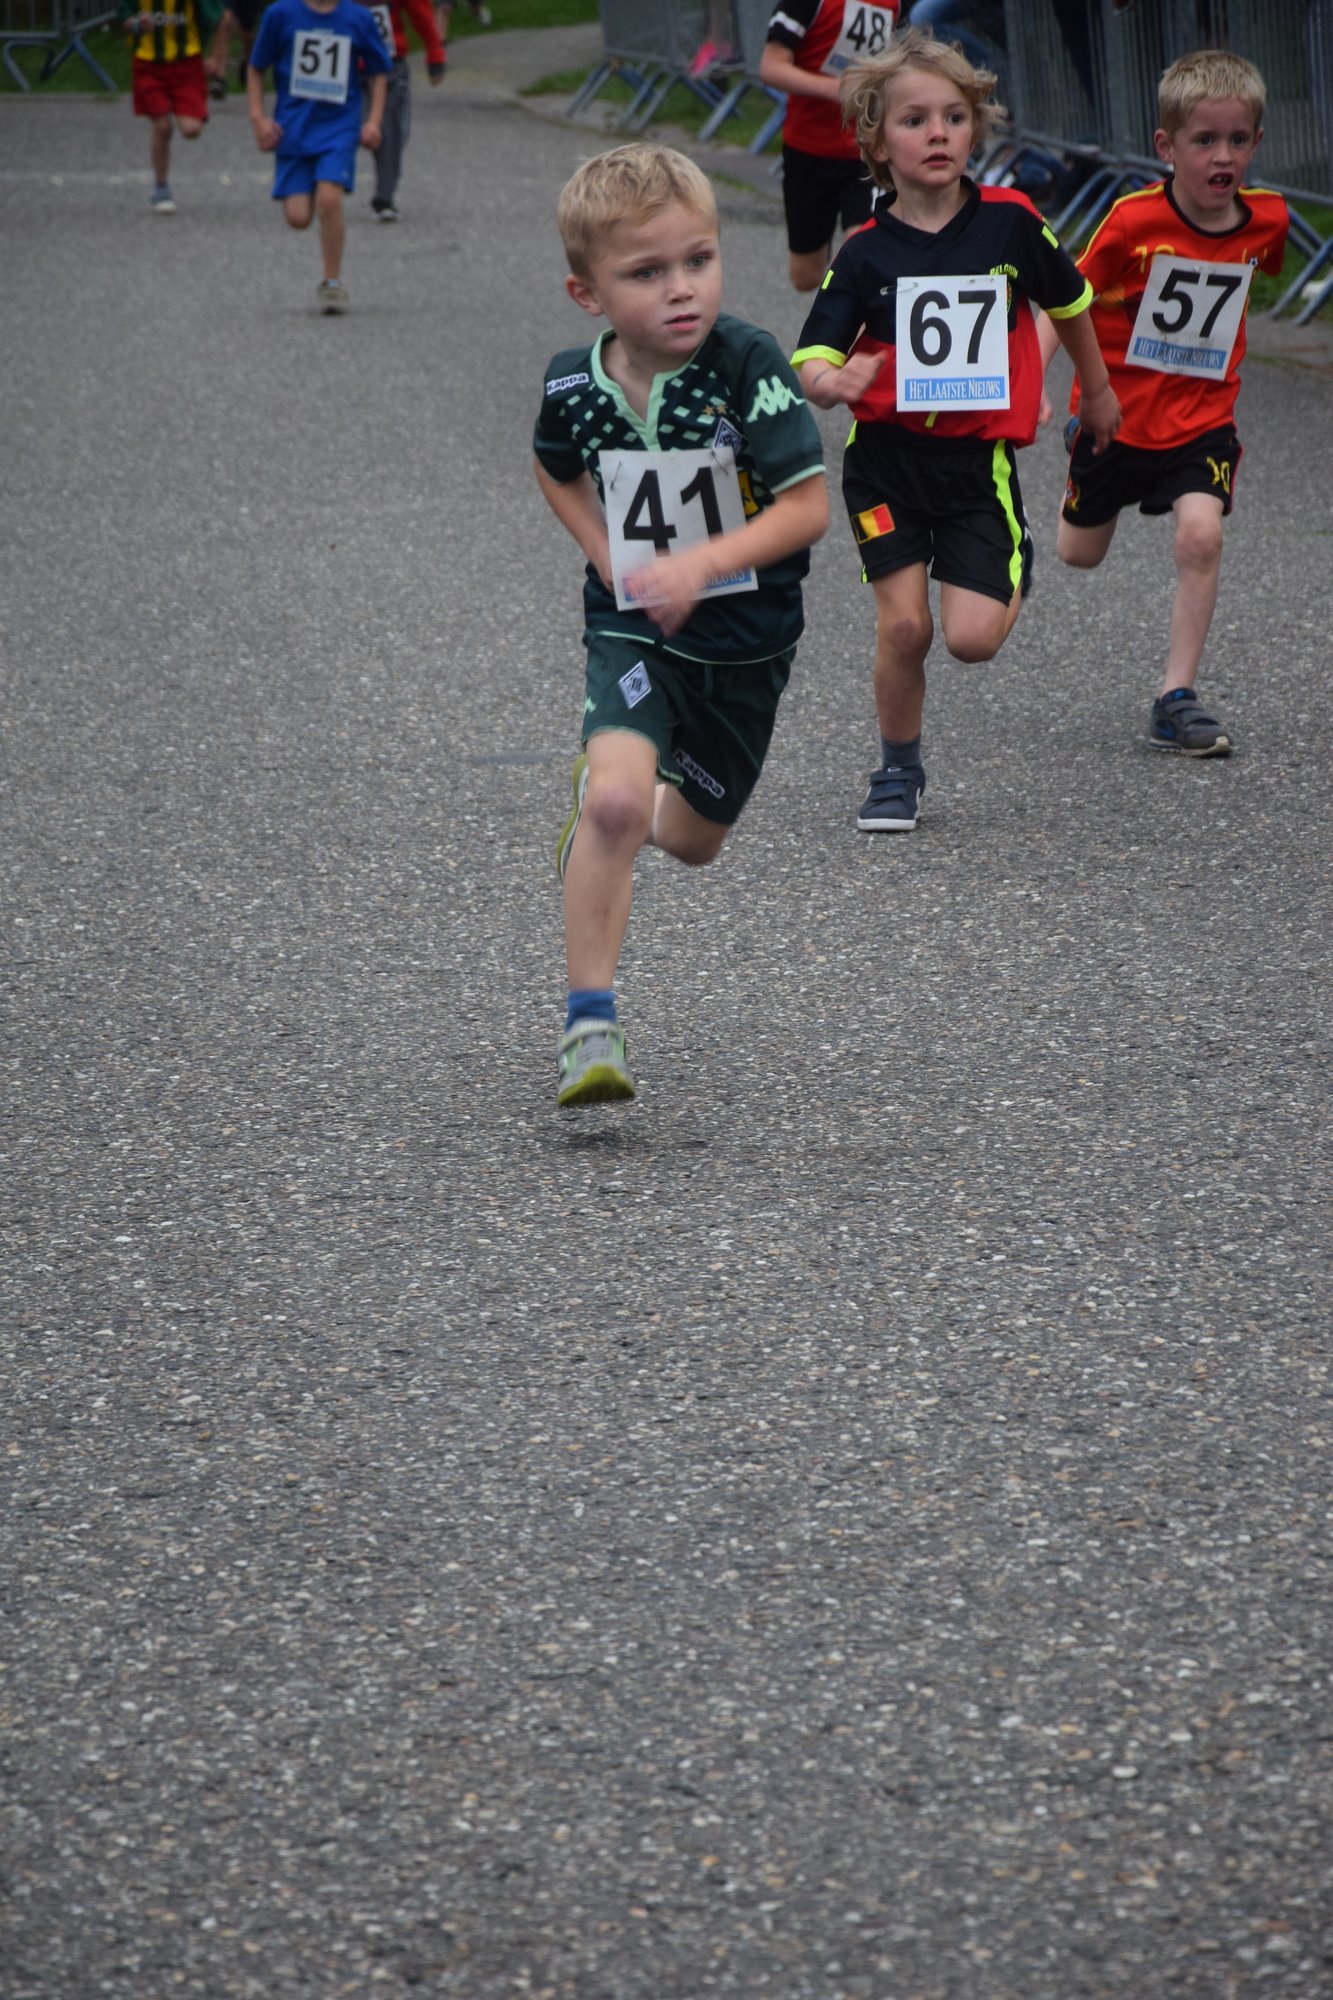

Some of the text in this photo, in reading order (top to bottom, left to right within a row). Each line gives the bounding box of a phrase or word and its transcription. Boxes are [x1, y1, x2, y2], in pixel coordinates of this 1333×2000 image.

[846, 6, 886, 57] 48
[299, 38, 339, 78] 51
[1152, 268, 1243, 338] 57
[910, 290, 997, 366] 67
[1137, 339, 1221, 368] HET LAATSTE NIEUWS
[546, 373, 589, 395] Kappa
[909, 378, 1001, 399] HET LAATSTE NIEUWS
[623, 466, 725, 557] 41
